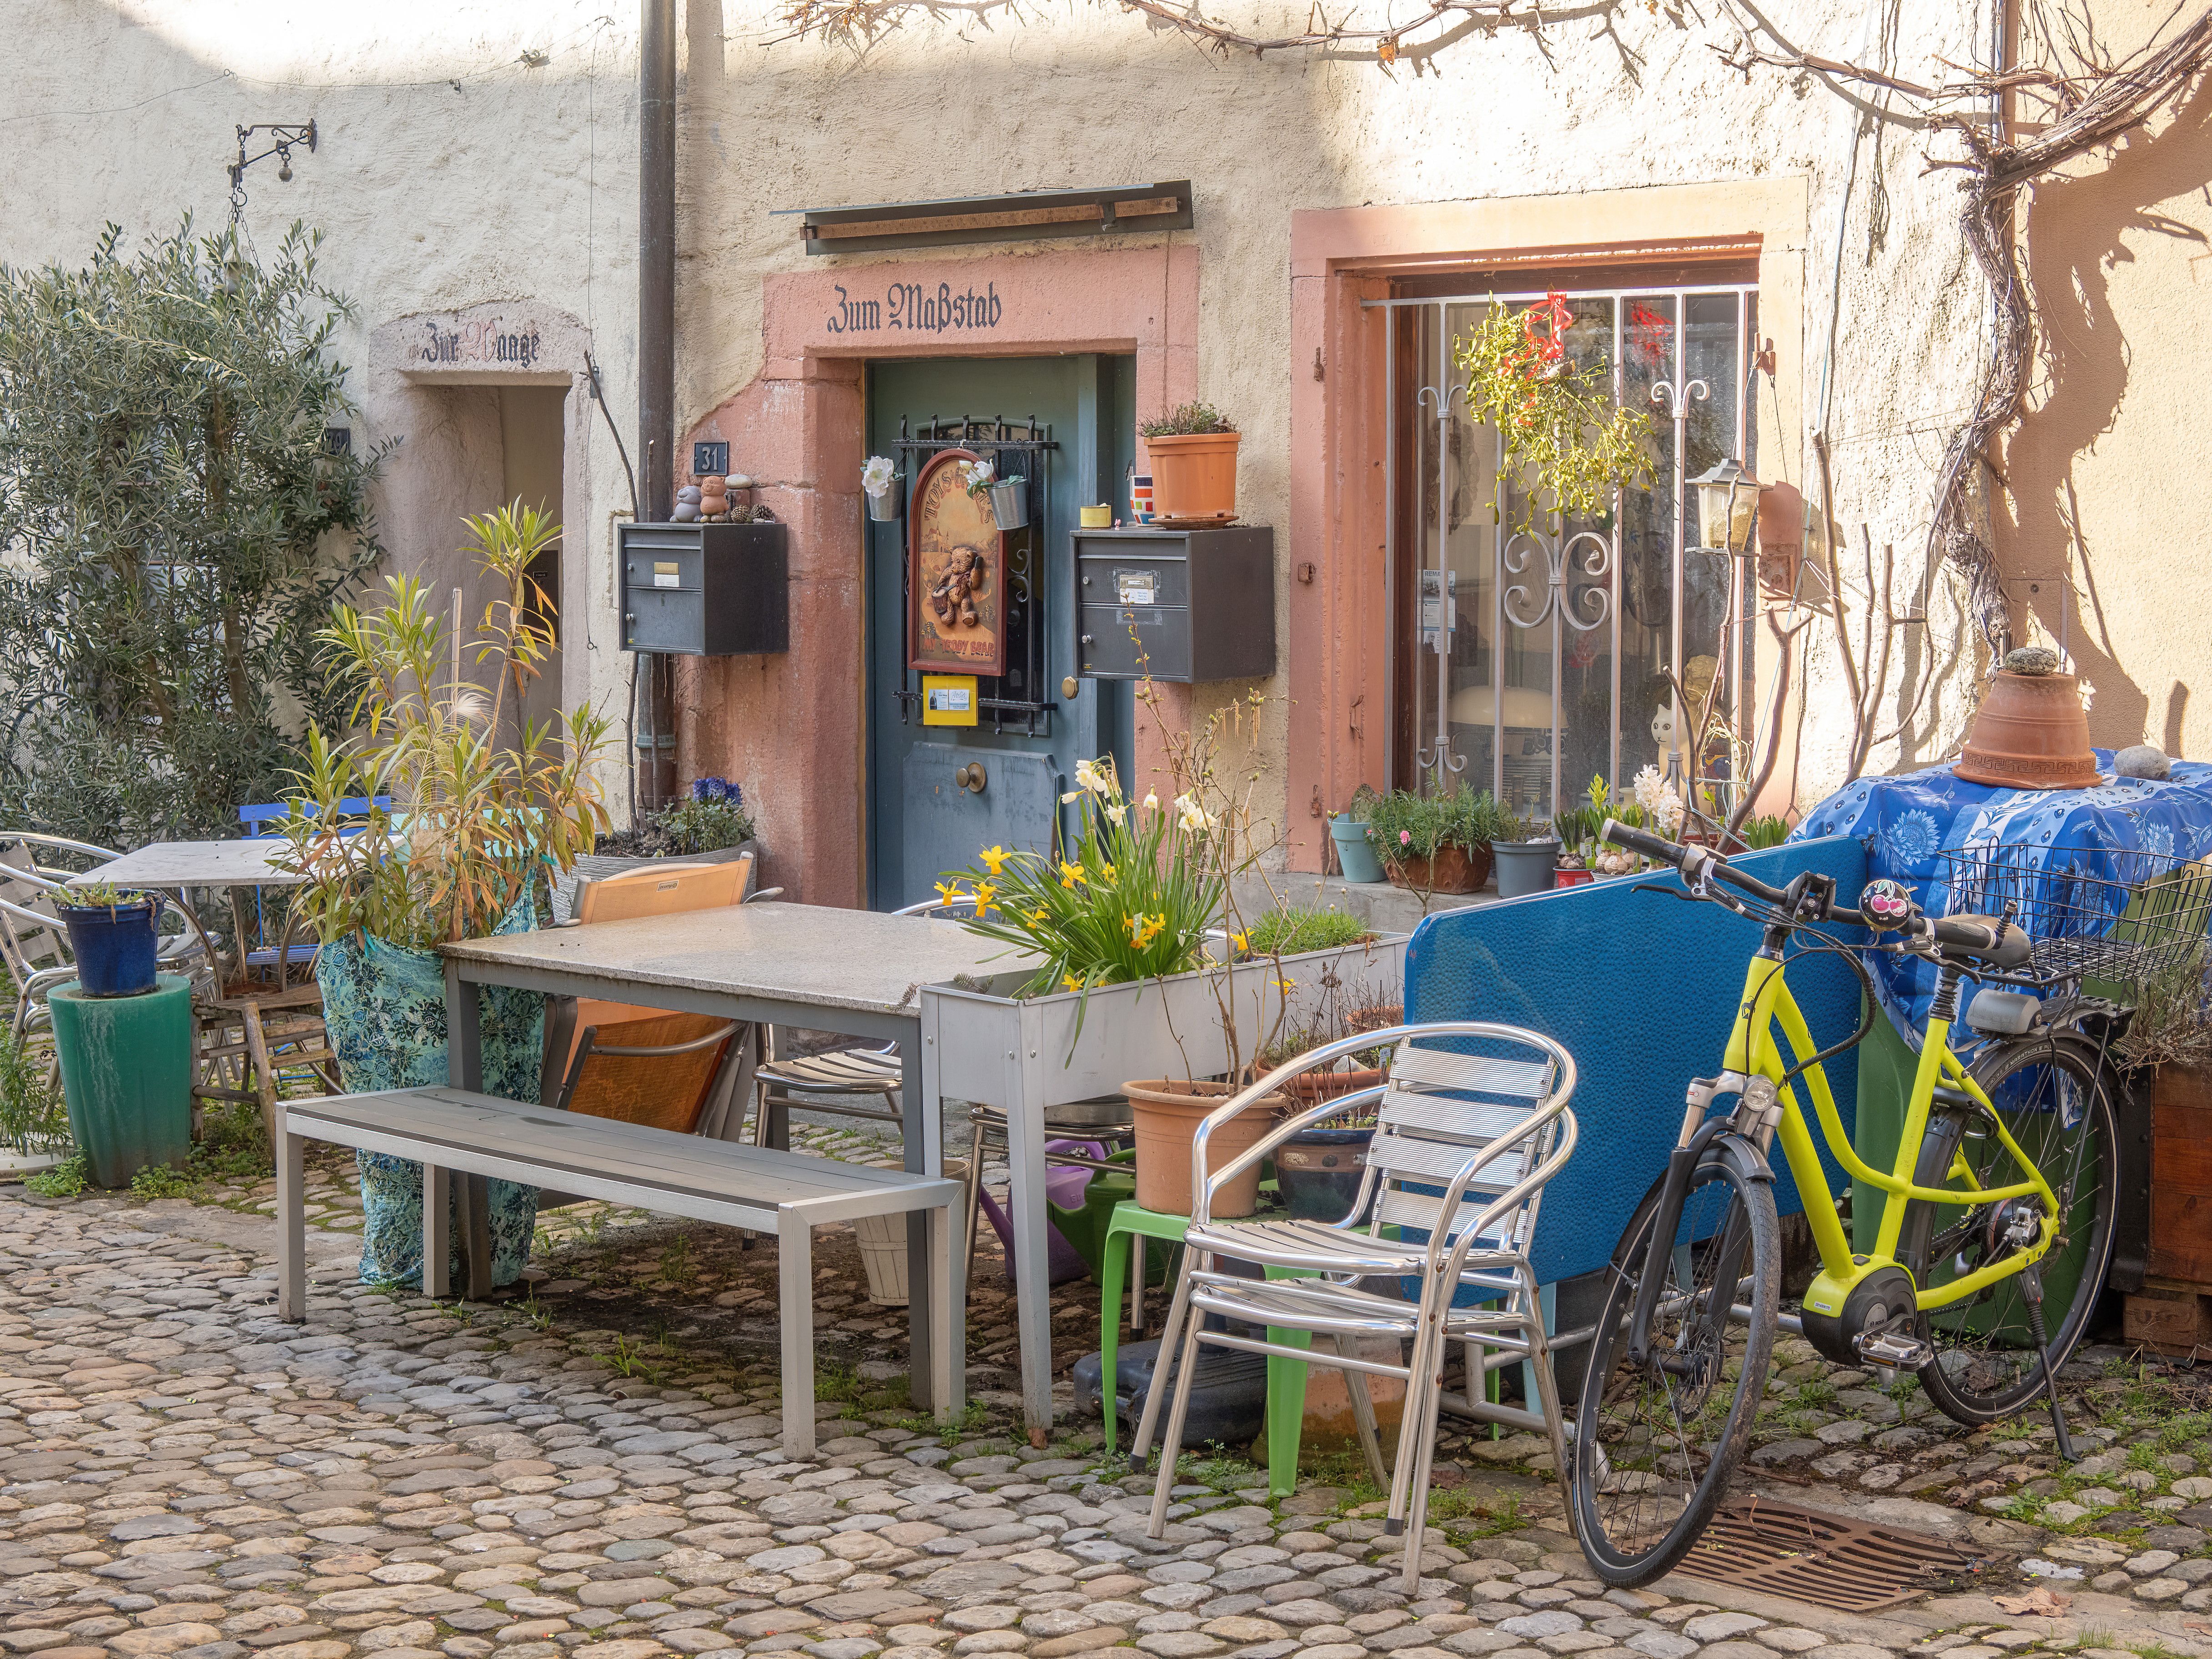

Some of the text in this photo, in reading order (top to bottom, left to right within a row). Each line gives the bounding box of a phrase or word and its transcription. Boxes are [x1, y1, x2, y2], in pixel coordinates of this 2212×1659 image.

[827, 281, 1002, 334] Zum Maßstab
[422, 322, 458, 362] Zur
[702, 446, 718, 471] 31
[925, 471, 952, 521] TOYS
[940, 639, 969, 655] TEDDY
[970, 641, 995, 657] BEAR
[2010, 1047, 2038, 1066] MARATHON
